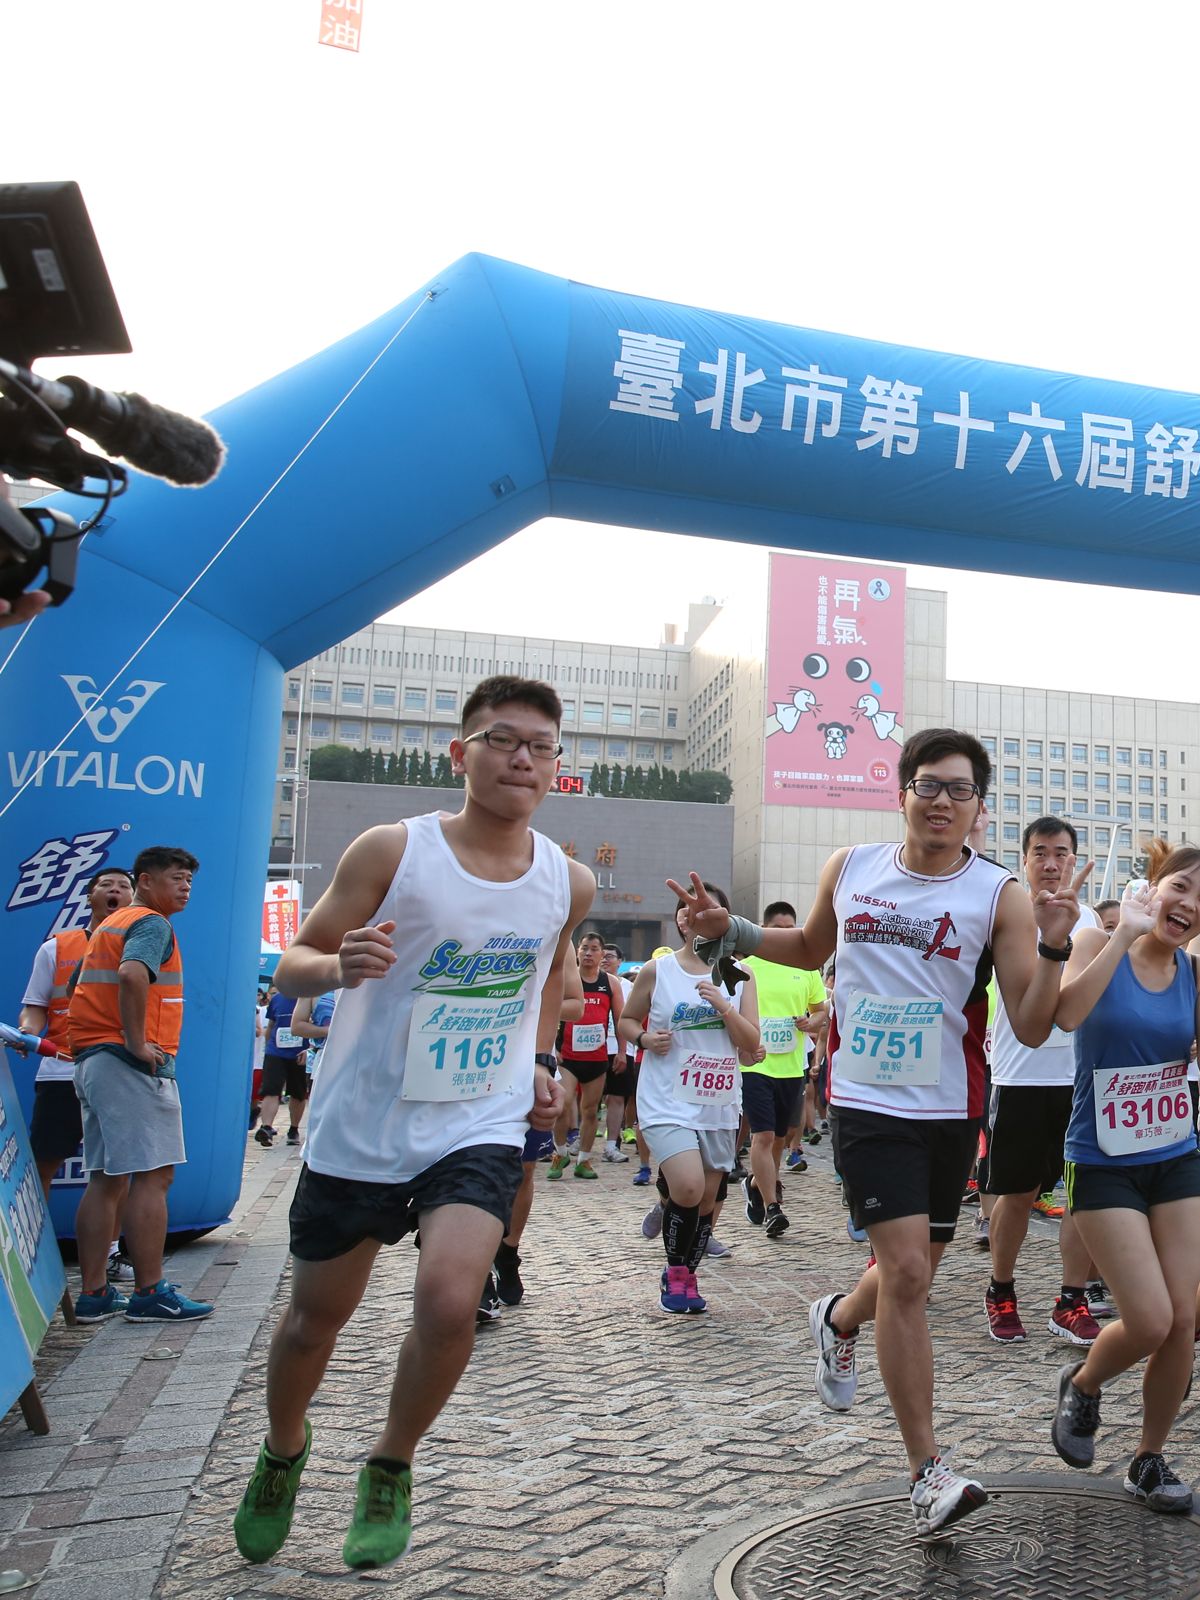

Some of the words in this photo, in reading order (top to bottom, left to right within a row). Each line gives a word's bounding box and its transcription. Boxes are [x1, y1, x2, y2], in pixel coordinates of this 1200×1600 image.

[7, 750, 205, 798] VITALON
[873, 768, 887, 777] 113
[851, 893, 898, 911] NISSAN
[881, 912, 912, 925] Action
[913, 917, 935, 930] Asia
[845, 921, 870, 930] X-Trail
[872, 922, 910, 935] TAIWAN
[911, 928, 934, 941] 2017
[487, 988, 516, 997] TAIPEI
[440, 1016, 494, 1031] 舒跑杯
[860, 1009, 900, 1025] 舒跑杯
[576, 1033, 602, 1044] 4462
[763, 1030, 793, 1043] 1029
[851, 1026, 923, 1060] 5751
[429, 1034, 508, 1070] 1163
[680, 1069, 735, 1092] 11883
[1117, 1080, 1159, 1096] 舒跑杯
[1102, 1092, 1189, 1129] 13106
